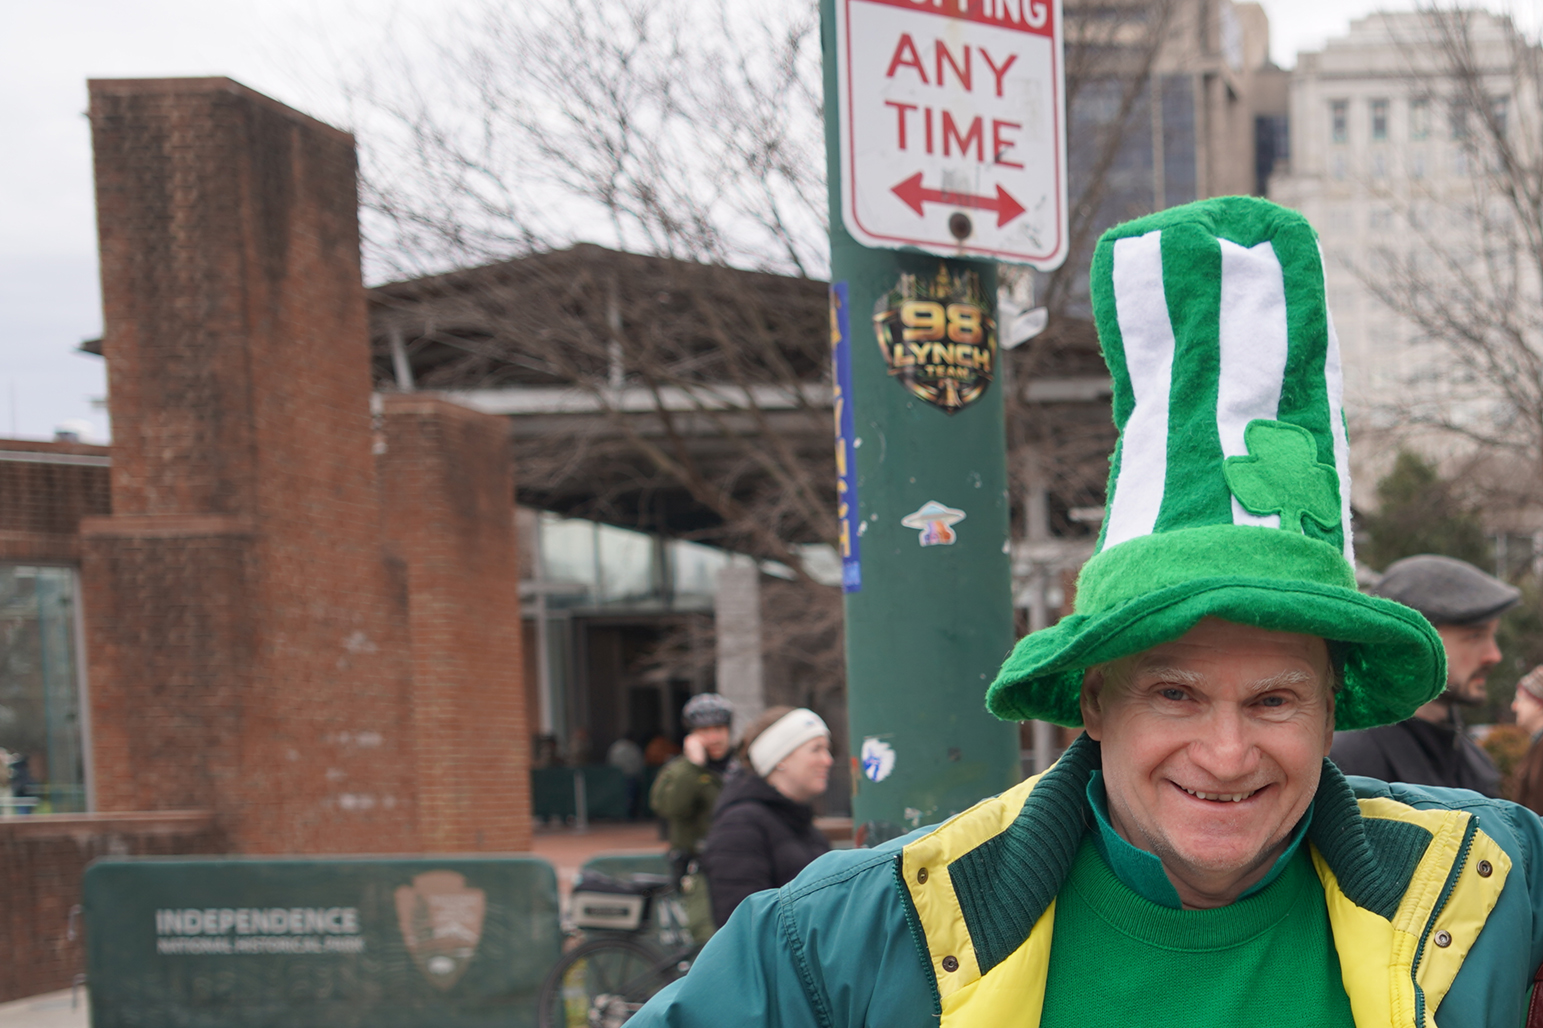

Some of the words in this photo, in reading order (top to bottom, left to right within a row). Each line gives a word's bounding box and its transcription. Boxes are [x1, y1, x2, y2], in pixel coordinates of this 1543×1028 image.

[886, 32, 1019, 98] ANY
[884, 100, 1024, 170] TIME
[901, 300, 984, 343] 98
[894, 342, 991, 372] LYNCH
[924, 364, 969, 378] TEAM
[156, 908, 359, 935] INDEPENDENCE
[157, 936, 233, 954] NATIONAL
